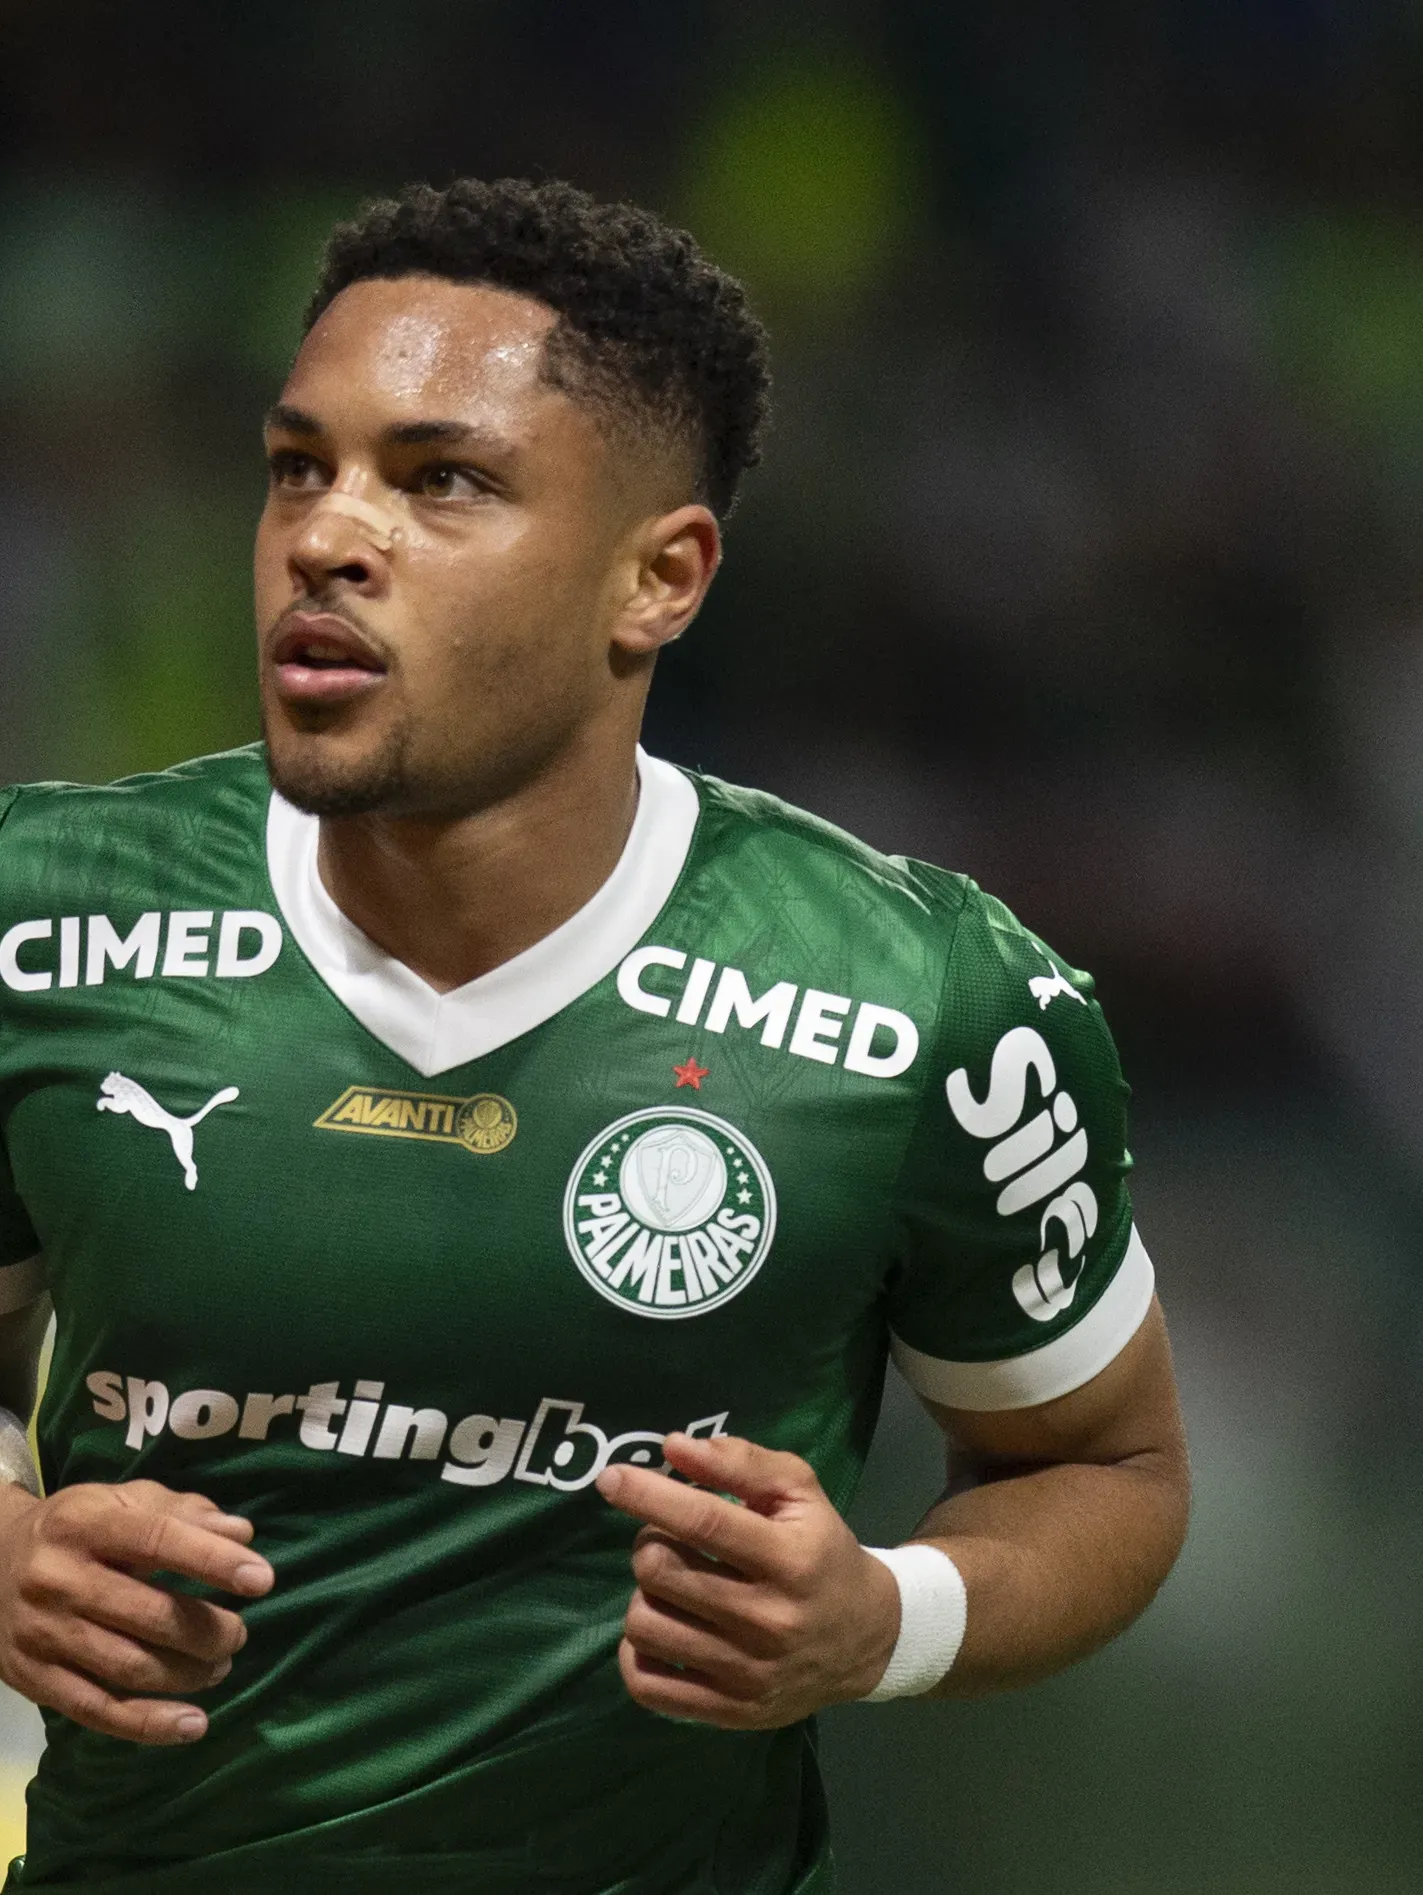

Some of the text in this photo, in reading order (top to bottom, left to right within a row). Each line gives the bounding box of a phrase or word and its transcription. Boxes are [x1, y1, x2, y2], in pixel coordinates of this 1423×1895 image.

[616, 945, 920, 1078] CIMED
[333, 1094, 456, 1134] AVANTI
[578, 1193, 761, 1305] PALMEIRAS
[85, 1369, 730, 1492] sportingbe
